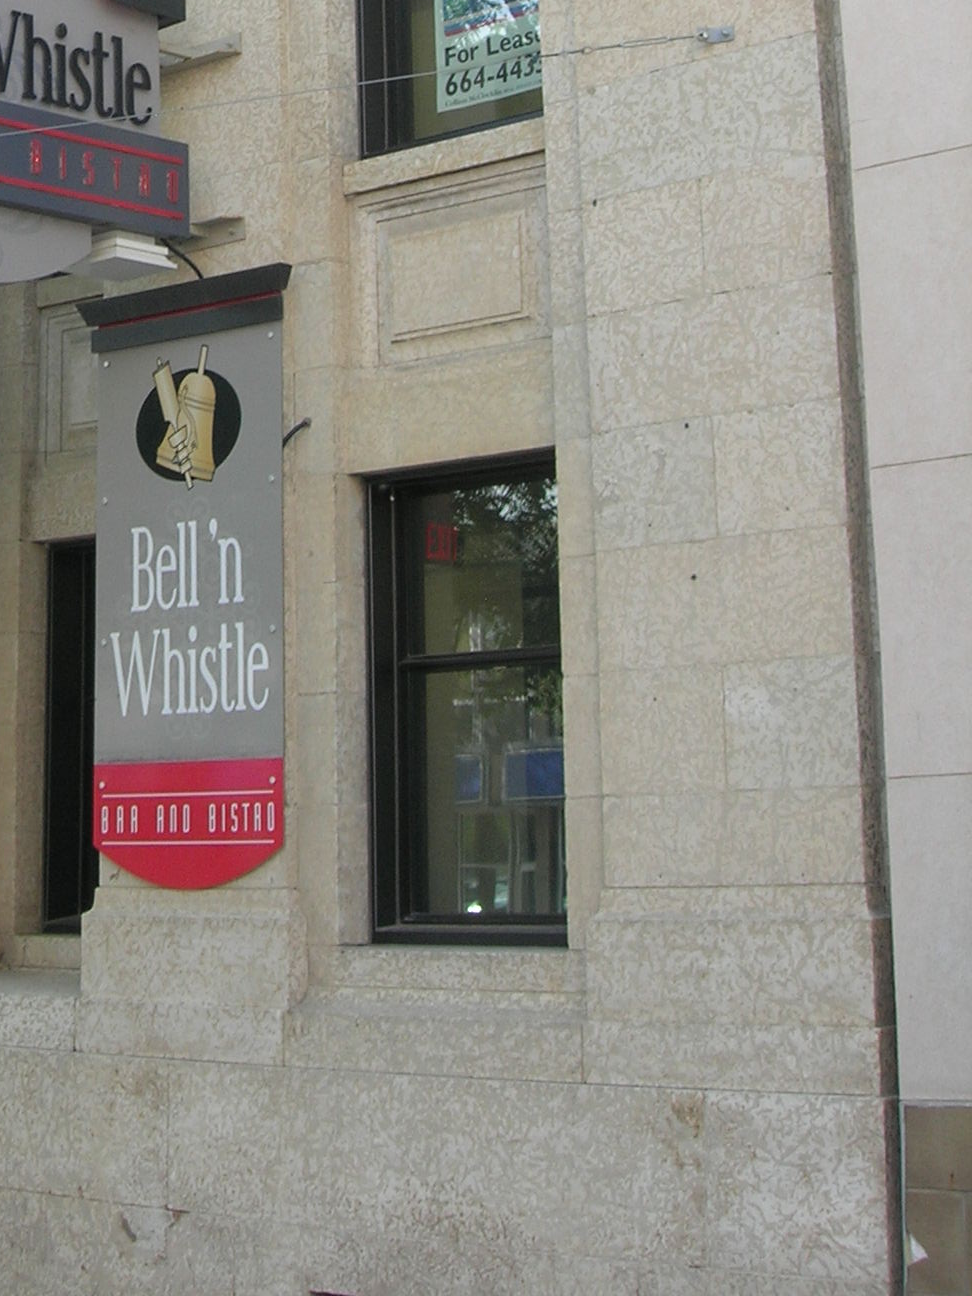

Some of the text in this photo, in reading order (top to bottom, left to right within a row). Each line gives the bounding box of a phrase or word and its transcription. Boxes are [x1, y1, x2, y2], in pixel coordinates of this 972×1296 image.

[444, 46, 479, 67] For
[29, 137, 179, 203] BISTRO
[131, 520, 200, 613] Bell
[110, 622, 269, 717] Whistle
[101, 801, 275, 834] BAR AND BISTRO
